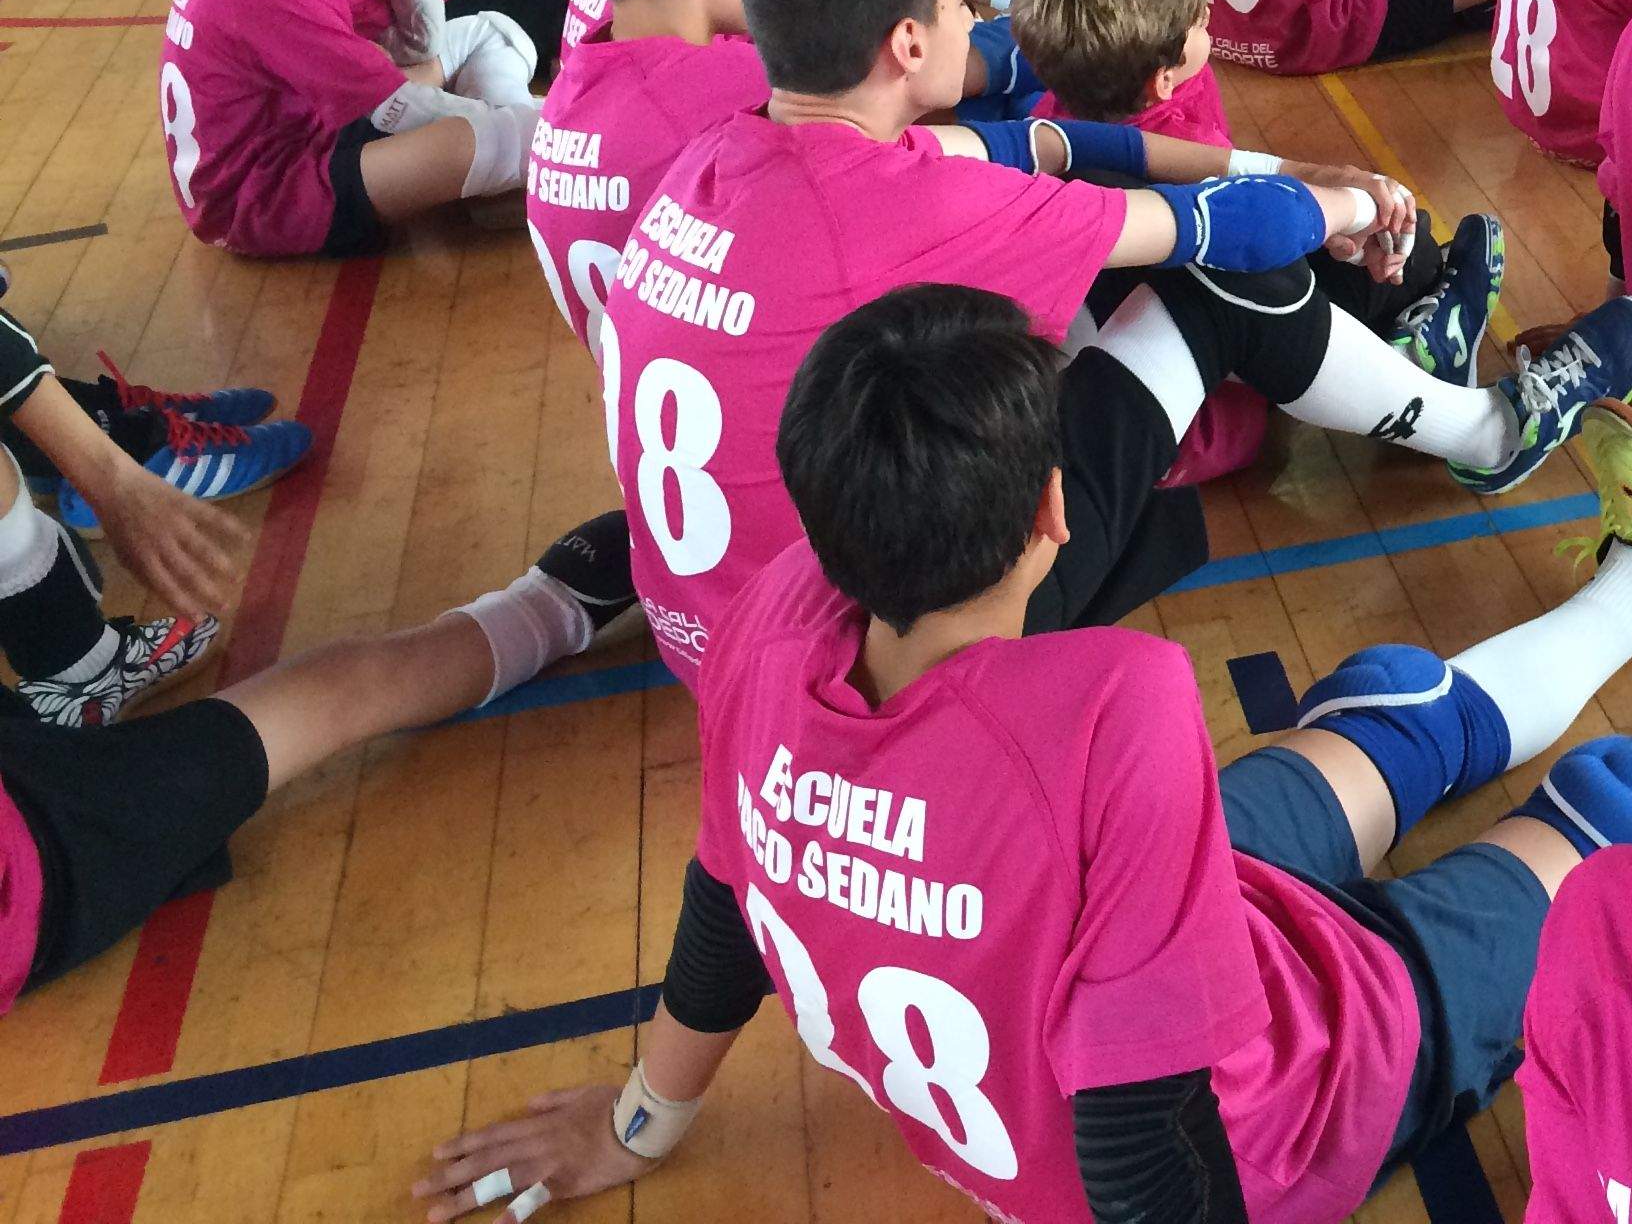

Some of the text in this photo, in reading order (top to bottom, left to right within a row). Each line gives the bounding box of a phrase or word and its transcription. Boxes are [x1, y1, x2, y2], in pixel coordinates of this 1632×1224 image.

[538, 166, 630, 212] SEDANO
[639, 193, 736, 275] ESCUELA
[637, 259, 756, 337] SEDANO
[797, 839, 984, 941] SEDANO
